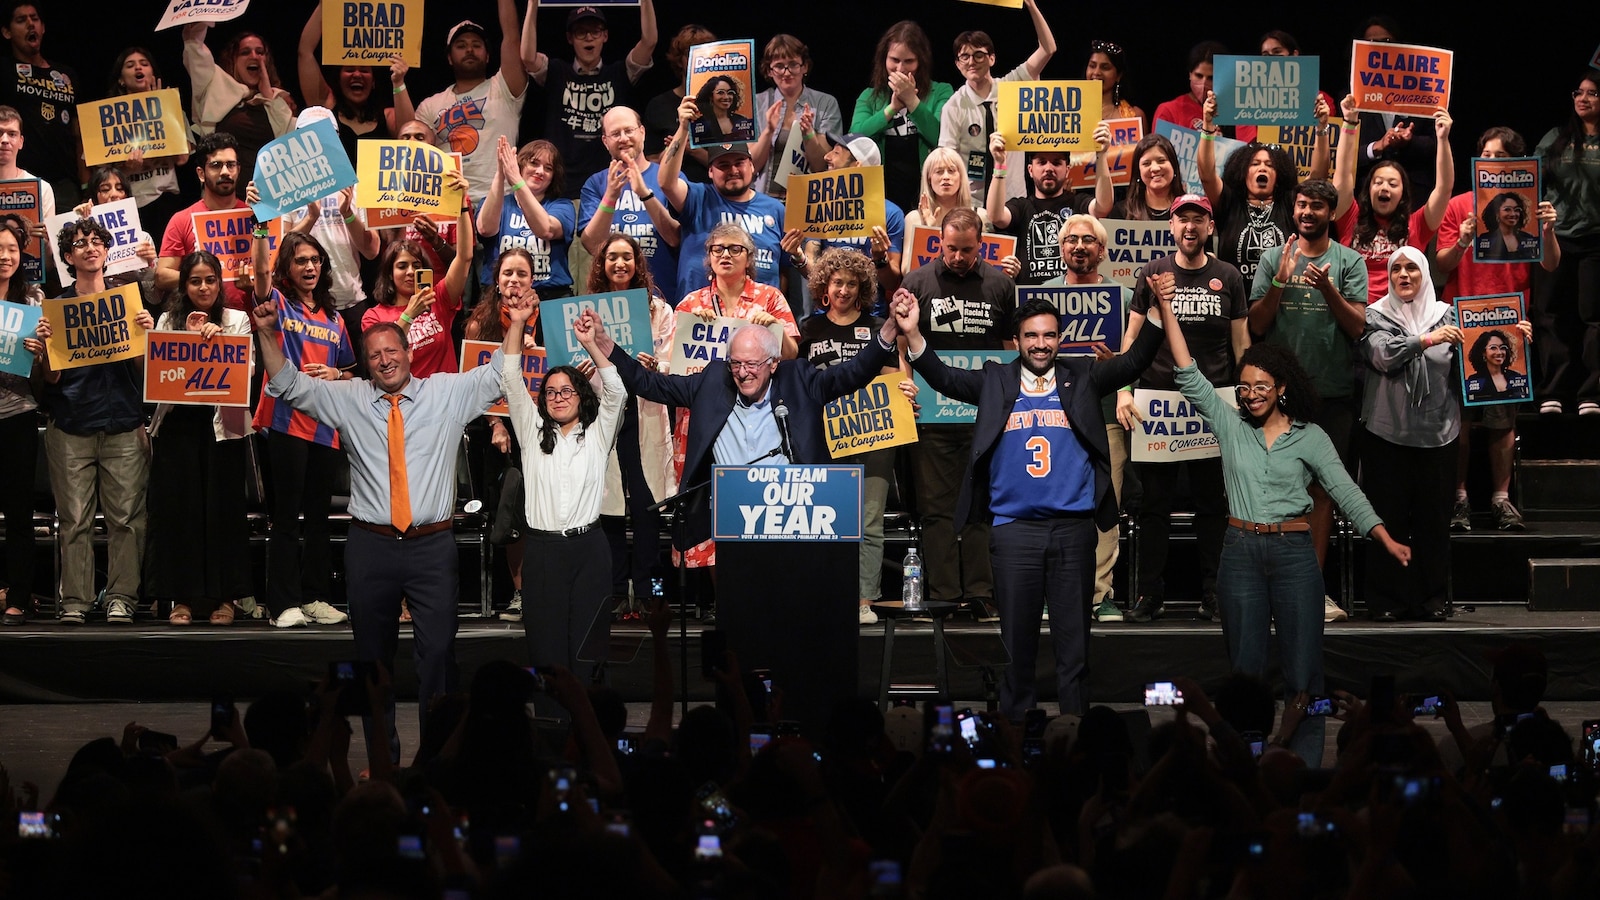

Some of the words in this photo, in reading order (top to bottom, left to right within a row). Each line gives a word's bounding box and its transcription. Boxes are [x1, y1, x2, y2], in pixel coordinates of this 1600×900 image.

[188, 5, 239, 17] CONGRESS
[343, 2, 405, 27] BRAD
[342, 28, 404, 49] LANDER
[342, 50, 360, 60] for
[695, 53, 747, 69] Darializa
[1368, 51, 1440, 74] CLAIRE
[17, 73, 74, 94] SUNRSE
[1235, 60, 1300, 87] BRAD
[1359, 71, 1445, 94] VALDEZ
[16, 84, 75, 104] MOVEMENT
[562, 87, 615, 112] NIOU
[1019, 87, 1082, 112] BRAD
[1235, 87, 1299, 109] LANDER
[1364, 92, 1383, 102] FOR
[1385, 92, 1440, 105] CONGRESS
[99, 96, 162, 128] BRAD
[436, 101, 484, 131] ICE
[1234, 109, 1253, 120] for
[1253, 108, 1298, 122] Congress
[102, 121, 166, 147] LANDER
[1018, 113, 1081, 134] LANDER
[105, 148, 122, 158] for
[123, 142, 166, 156] Congress
[1017, 135, 1036, 146] for
[1037, 134, 1080, 147] Congress
[257, 130, 324, 180] BRAD
[380, 146, 443, 173] BRAD
[265, 154, 334, 200] LANDER
[378, 171, 442, 197] LANDER
[1480, 170, 1534, 184] Darializa
[277, 195, 294, 211] for
[293, 177, 337, 201] Congress
[808, 173, 864, 204] BRAD
[377, 194, 395, 203] for
[396, 193, 440, 207] Congress
[380, 208, 398, 219] FOR
[510, 213, 531, 230] UA
[805, 199, 864, 224] LANDER
[206, 217, 254, 238] CLAIR
[610, 223, 653, 237] CLAIRE
[721, 211, 764, 234] UAW
[803, 225, 821, 234] for
[822, 222, 864, 235] Congress
[203, 235, 276, 256] VALDZ
[1115, 228, 1176, 246] CLAIR
[105, 247, 136, 262] NGRESS
[1029, 260, 1068, 271] OPEIU
[1112, 268, 1131, 278] FOR
[1173, 293, 1221, 302] OCRATIC
[1196, 286, 1209, 295] City
[63, 294, 126, 329] BRAD
[964, 300, 981, 309] Jews
[981, 301, 991, 310] For
[964, 308, 984, 317] Racial
[984, 310, 990, 318] &
[1171, 301, 1222, 317] CIALISTS
[1462, 307, 1518, 323] Darializa
[964, 316, 994, 327] Economic
[1179, 314, 1205, 322] America
[66, 320, 130, 350] LANDER
[282, 317, 305, 333] NEW
[305, 324, 330, 341] YORK
[964, 325, 986, 334] Justice
[1061, 317, 1106, 342] ALL
[69, 350, 87, 362] for
[88, 344, 130, 359] Congress
[151, 341, 247, 364] MEDICARE
[160, 367, 186, 383] FOR
[185, 367, 231, 390] ALL
[826, 382, 889, 419] BRAD
[936, 406, 955, 417] for
[827, 408, 894, 441] LANDER
[832, 436, 850, 452] for
[850, 431, 895, 447] Congress
[1148, 441, 1167, 452] FOR
[1169, 436, 1219, 452] CONGRES
[1025, 435, 1052, 478] 3
[747, 467, 780, 483] OUR
[785, 467, 828, 483] TEAM
[763, 482, 815, 506] OUR
[739, 505, 837, 535] YEAR
